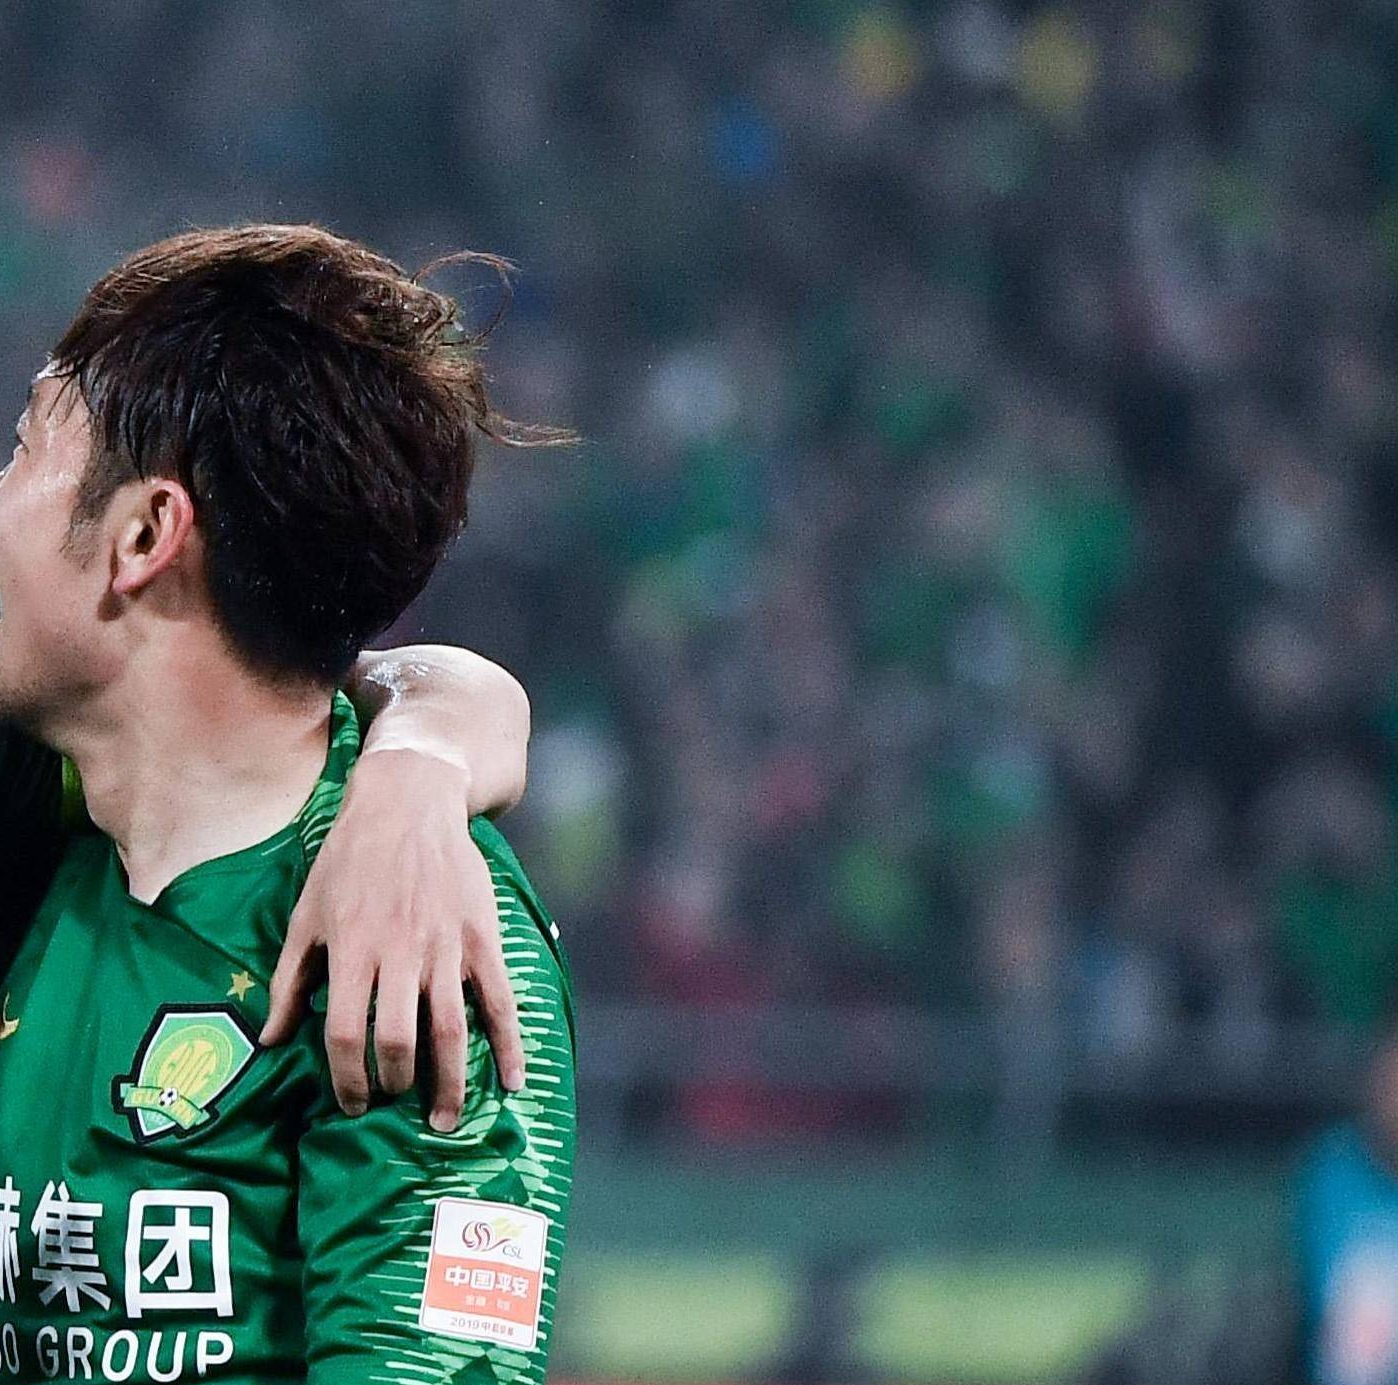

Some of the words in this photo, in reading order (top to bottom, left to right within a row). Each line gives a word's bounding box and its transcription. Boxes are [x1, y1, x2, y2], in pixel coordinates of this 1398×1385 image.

[445, 1265, 530, 1299] 中国平安
[36, 1325, 234, 1382] GROUP
